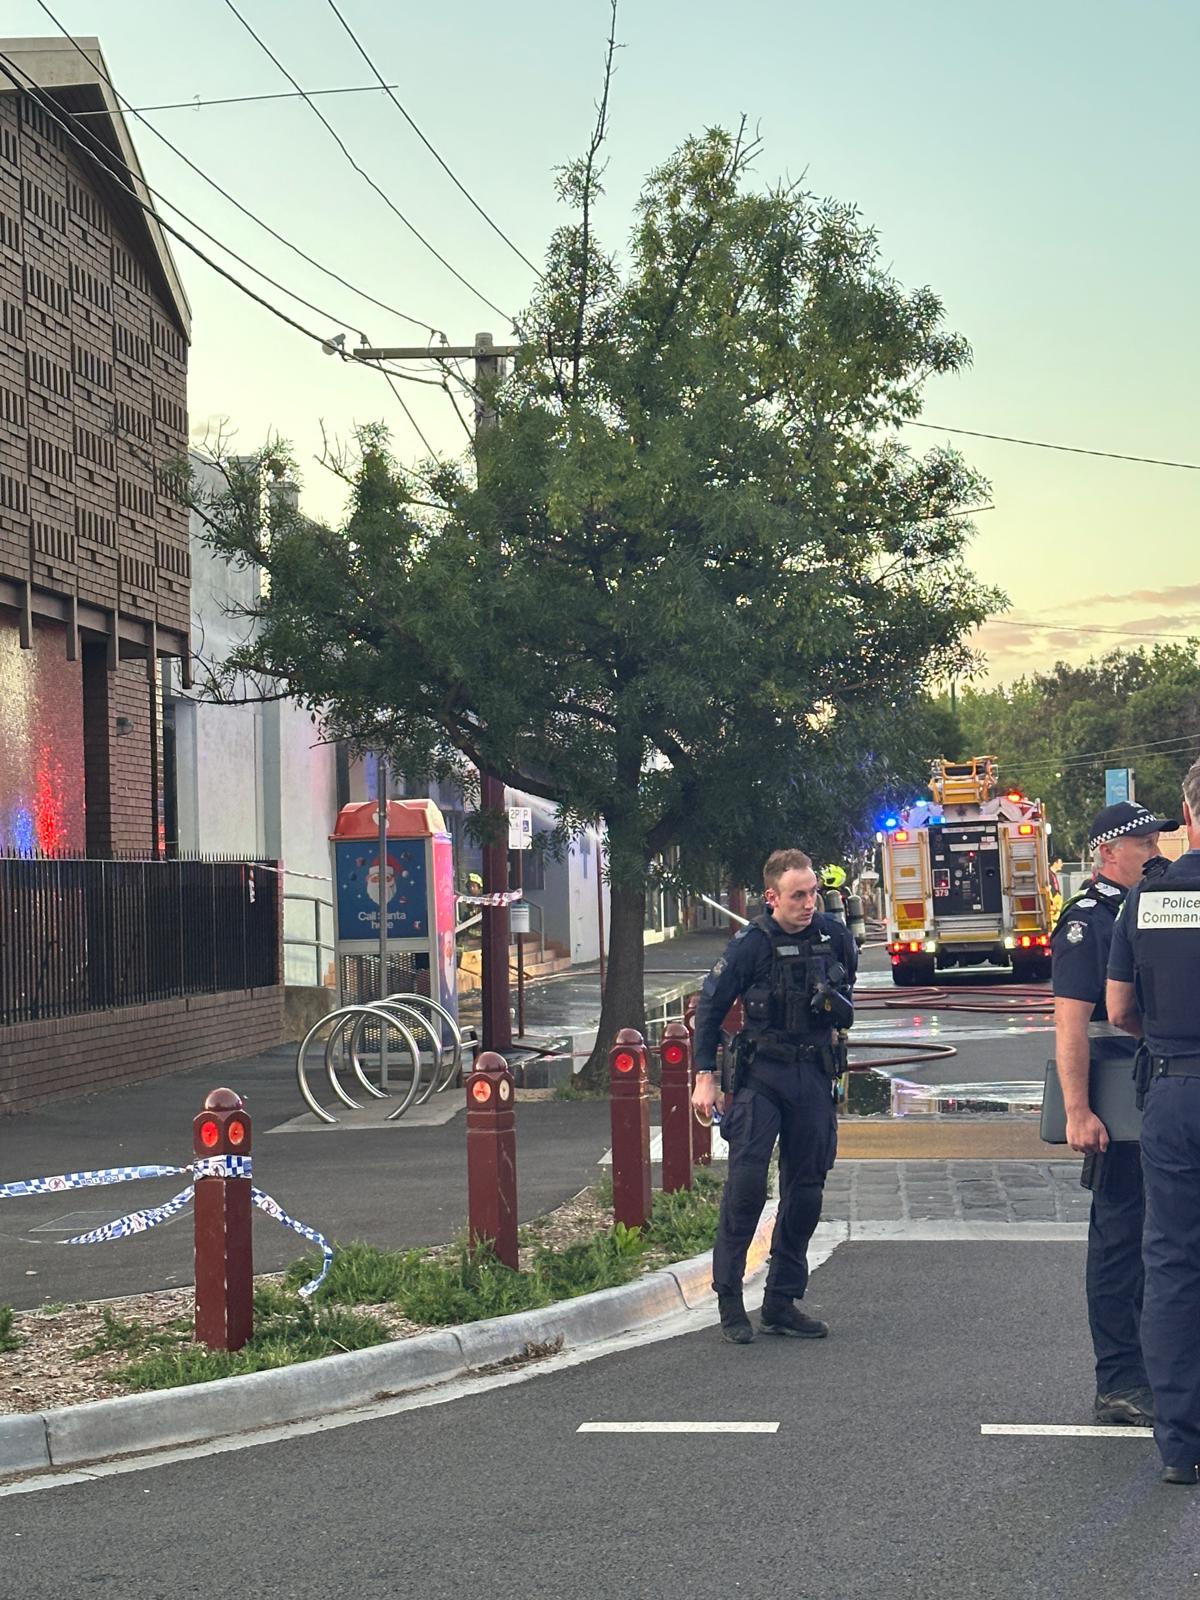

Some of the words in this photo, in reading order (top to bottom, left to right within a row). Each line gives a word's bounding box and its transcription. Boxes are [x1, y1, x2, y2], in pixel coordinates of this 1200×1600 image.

[510, 809, 519, 819] 2P
[934, 889, 949, 897] 379
[1162, 897, 1200, 909] Police
[358, 911, 376, 921] Call
[1142, 911, 1200, 923] Comman
